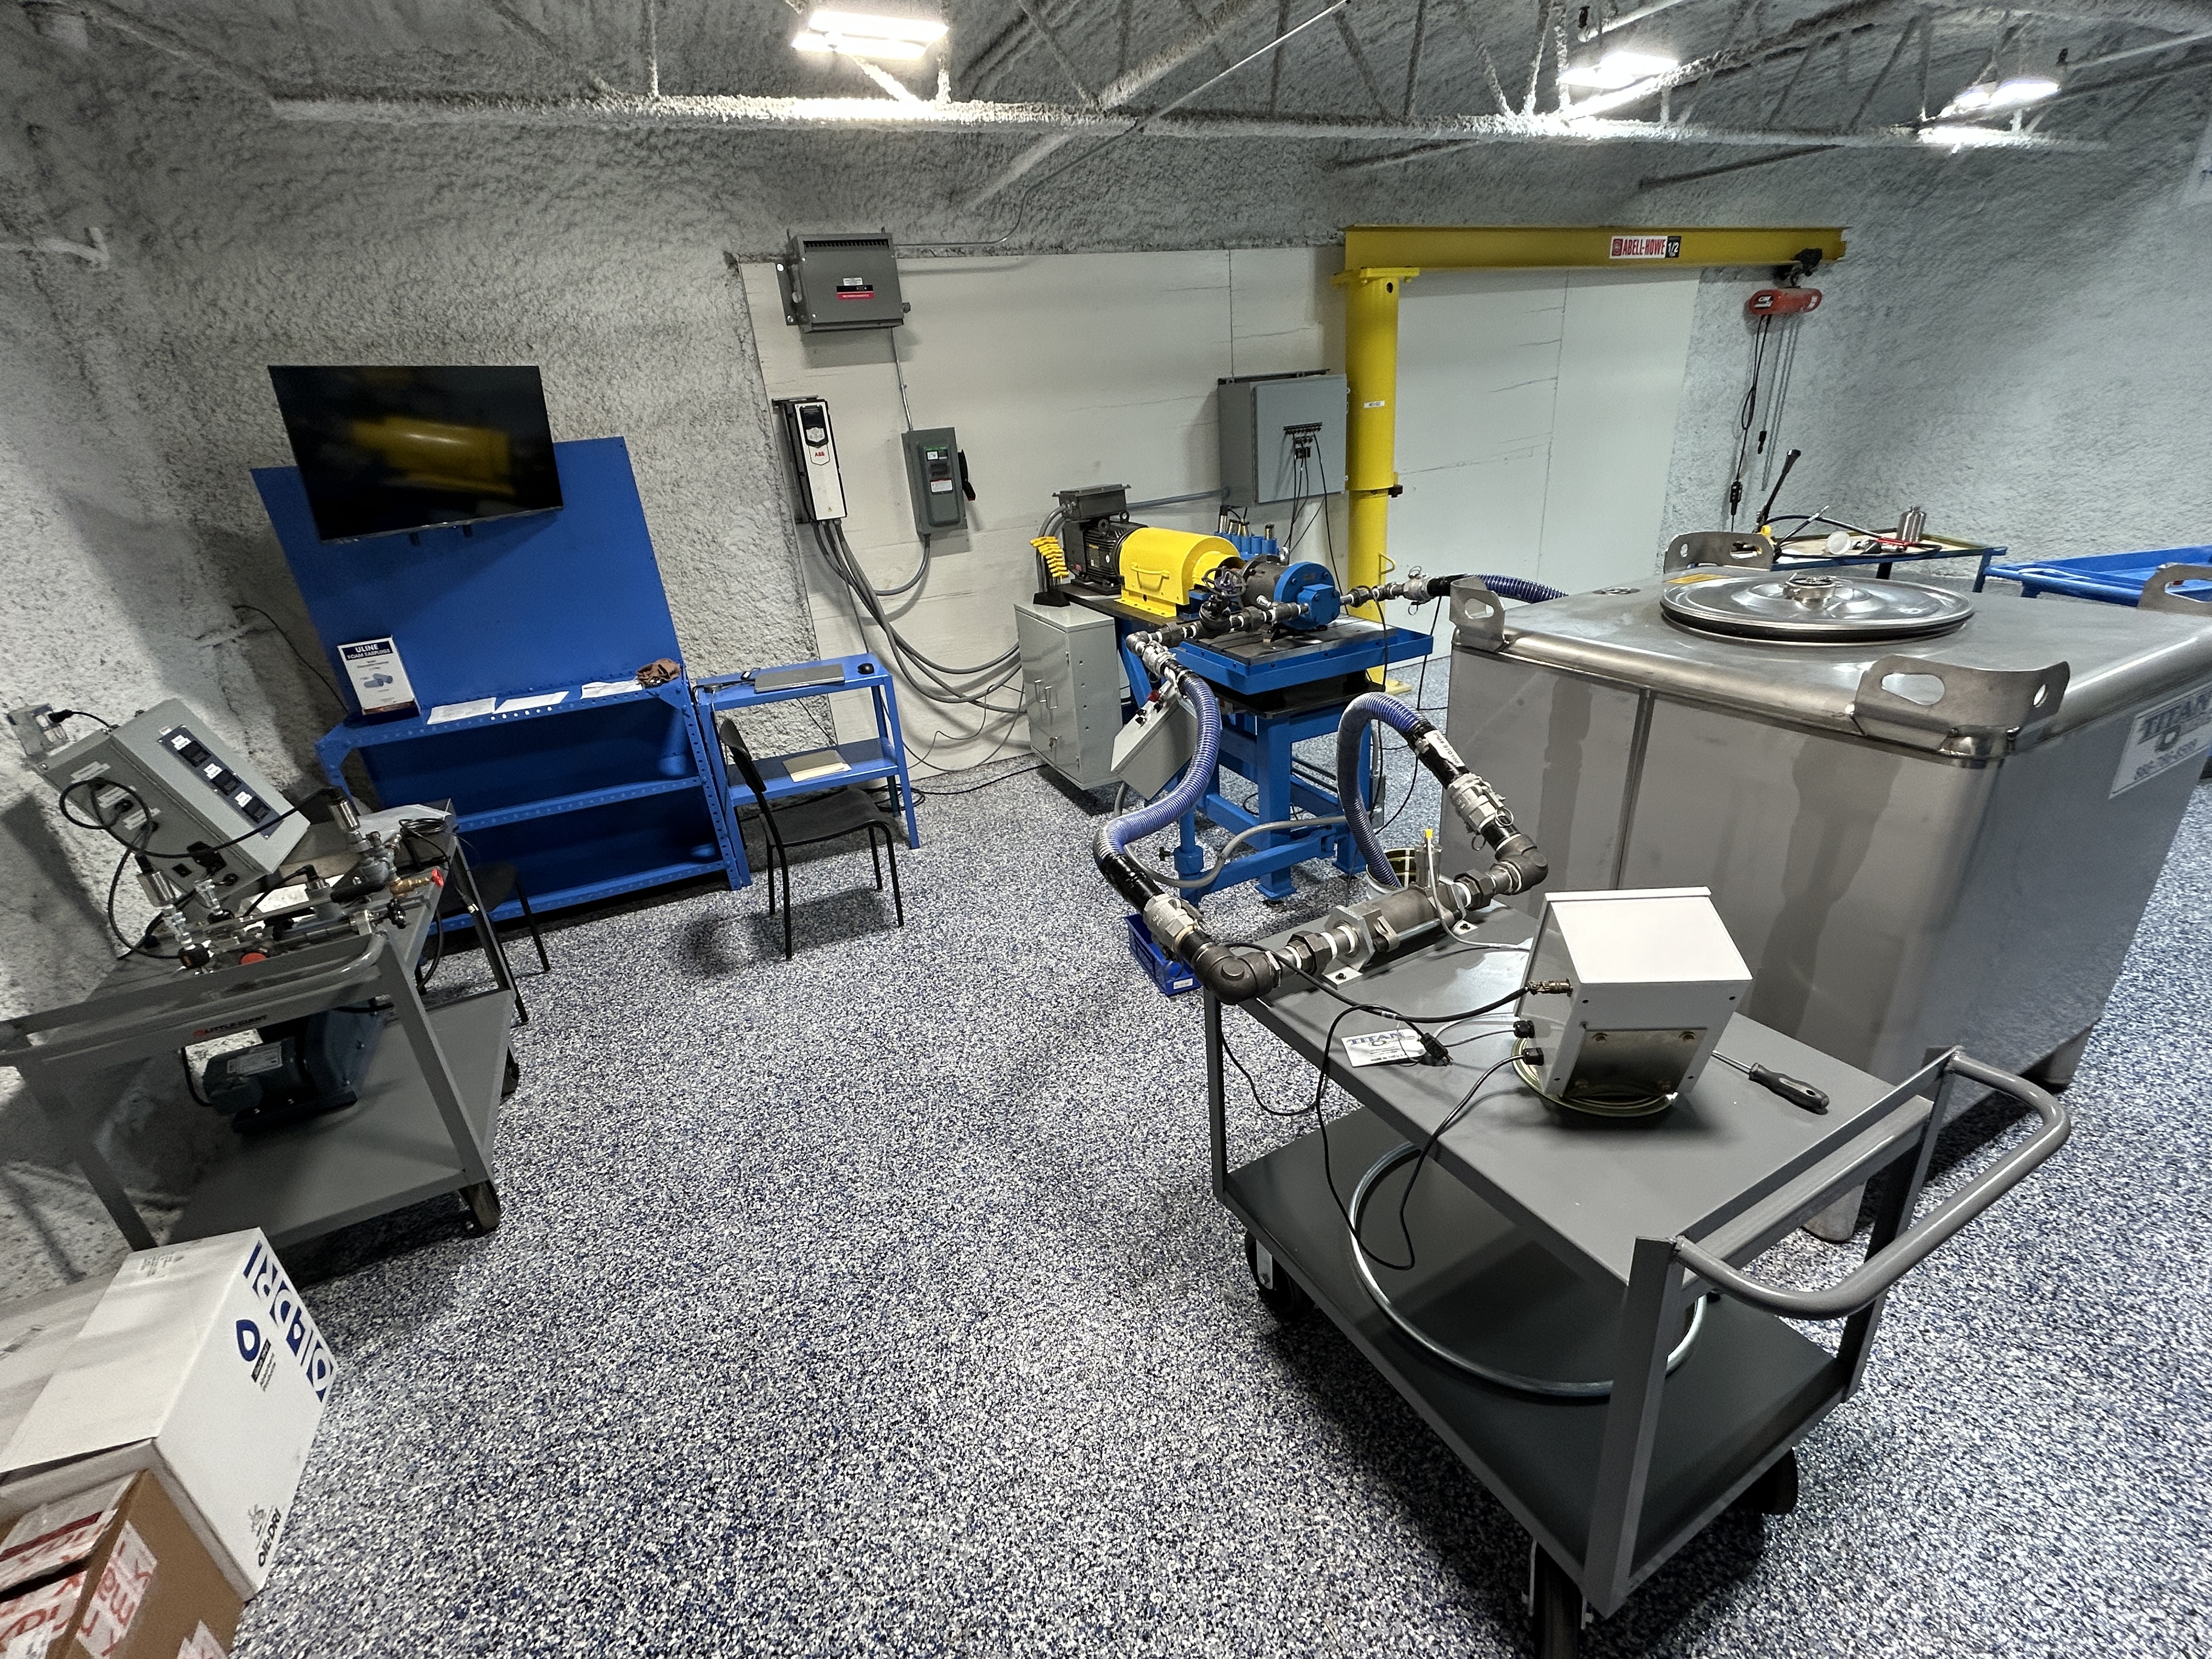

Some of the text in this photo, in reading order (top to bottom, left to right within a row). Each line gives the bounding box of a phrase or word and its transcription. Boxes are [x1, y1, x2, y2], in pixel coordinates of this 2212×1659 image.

[1622, 239, 1679, 255] ABELL-HOWE 1/2
[355, 644, 379, 652] ULINE
[365, 648, 391, 657] EARPLUGS
[2141, 691, 2212, 739] TITAN
[1350, 1032, 1403, 1045] TITAN
